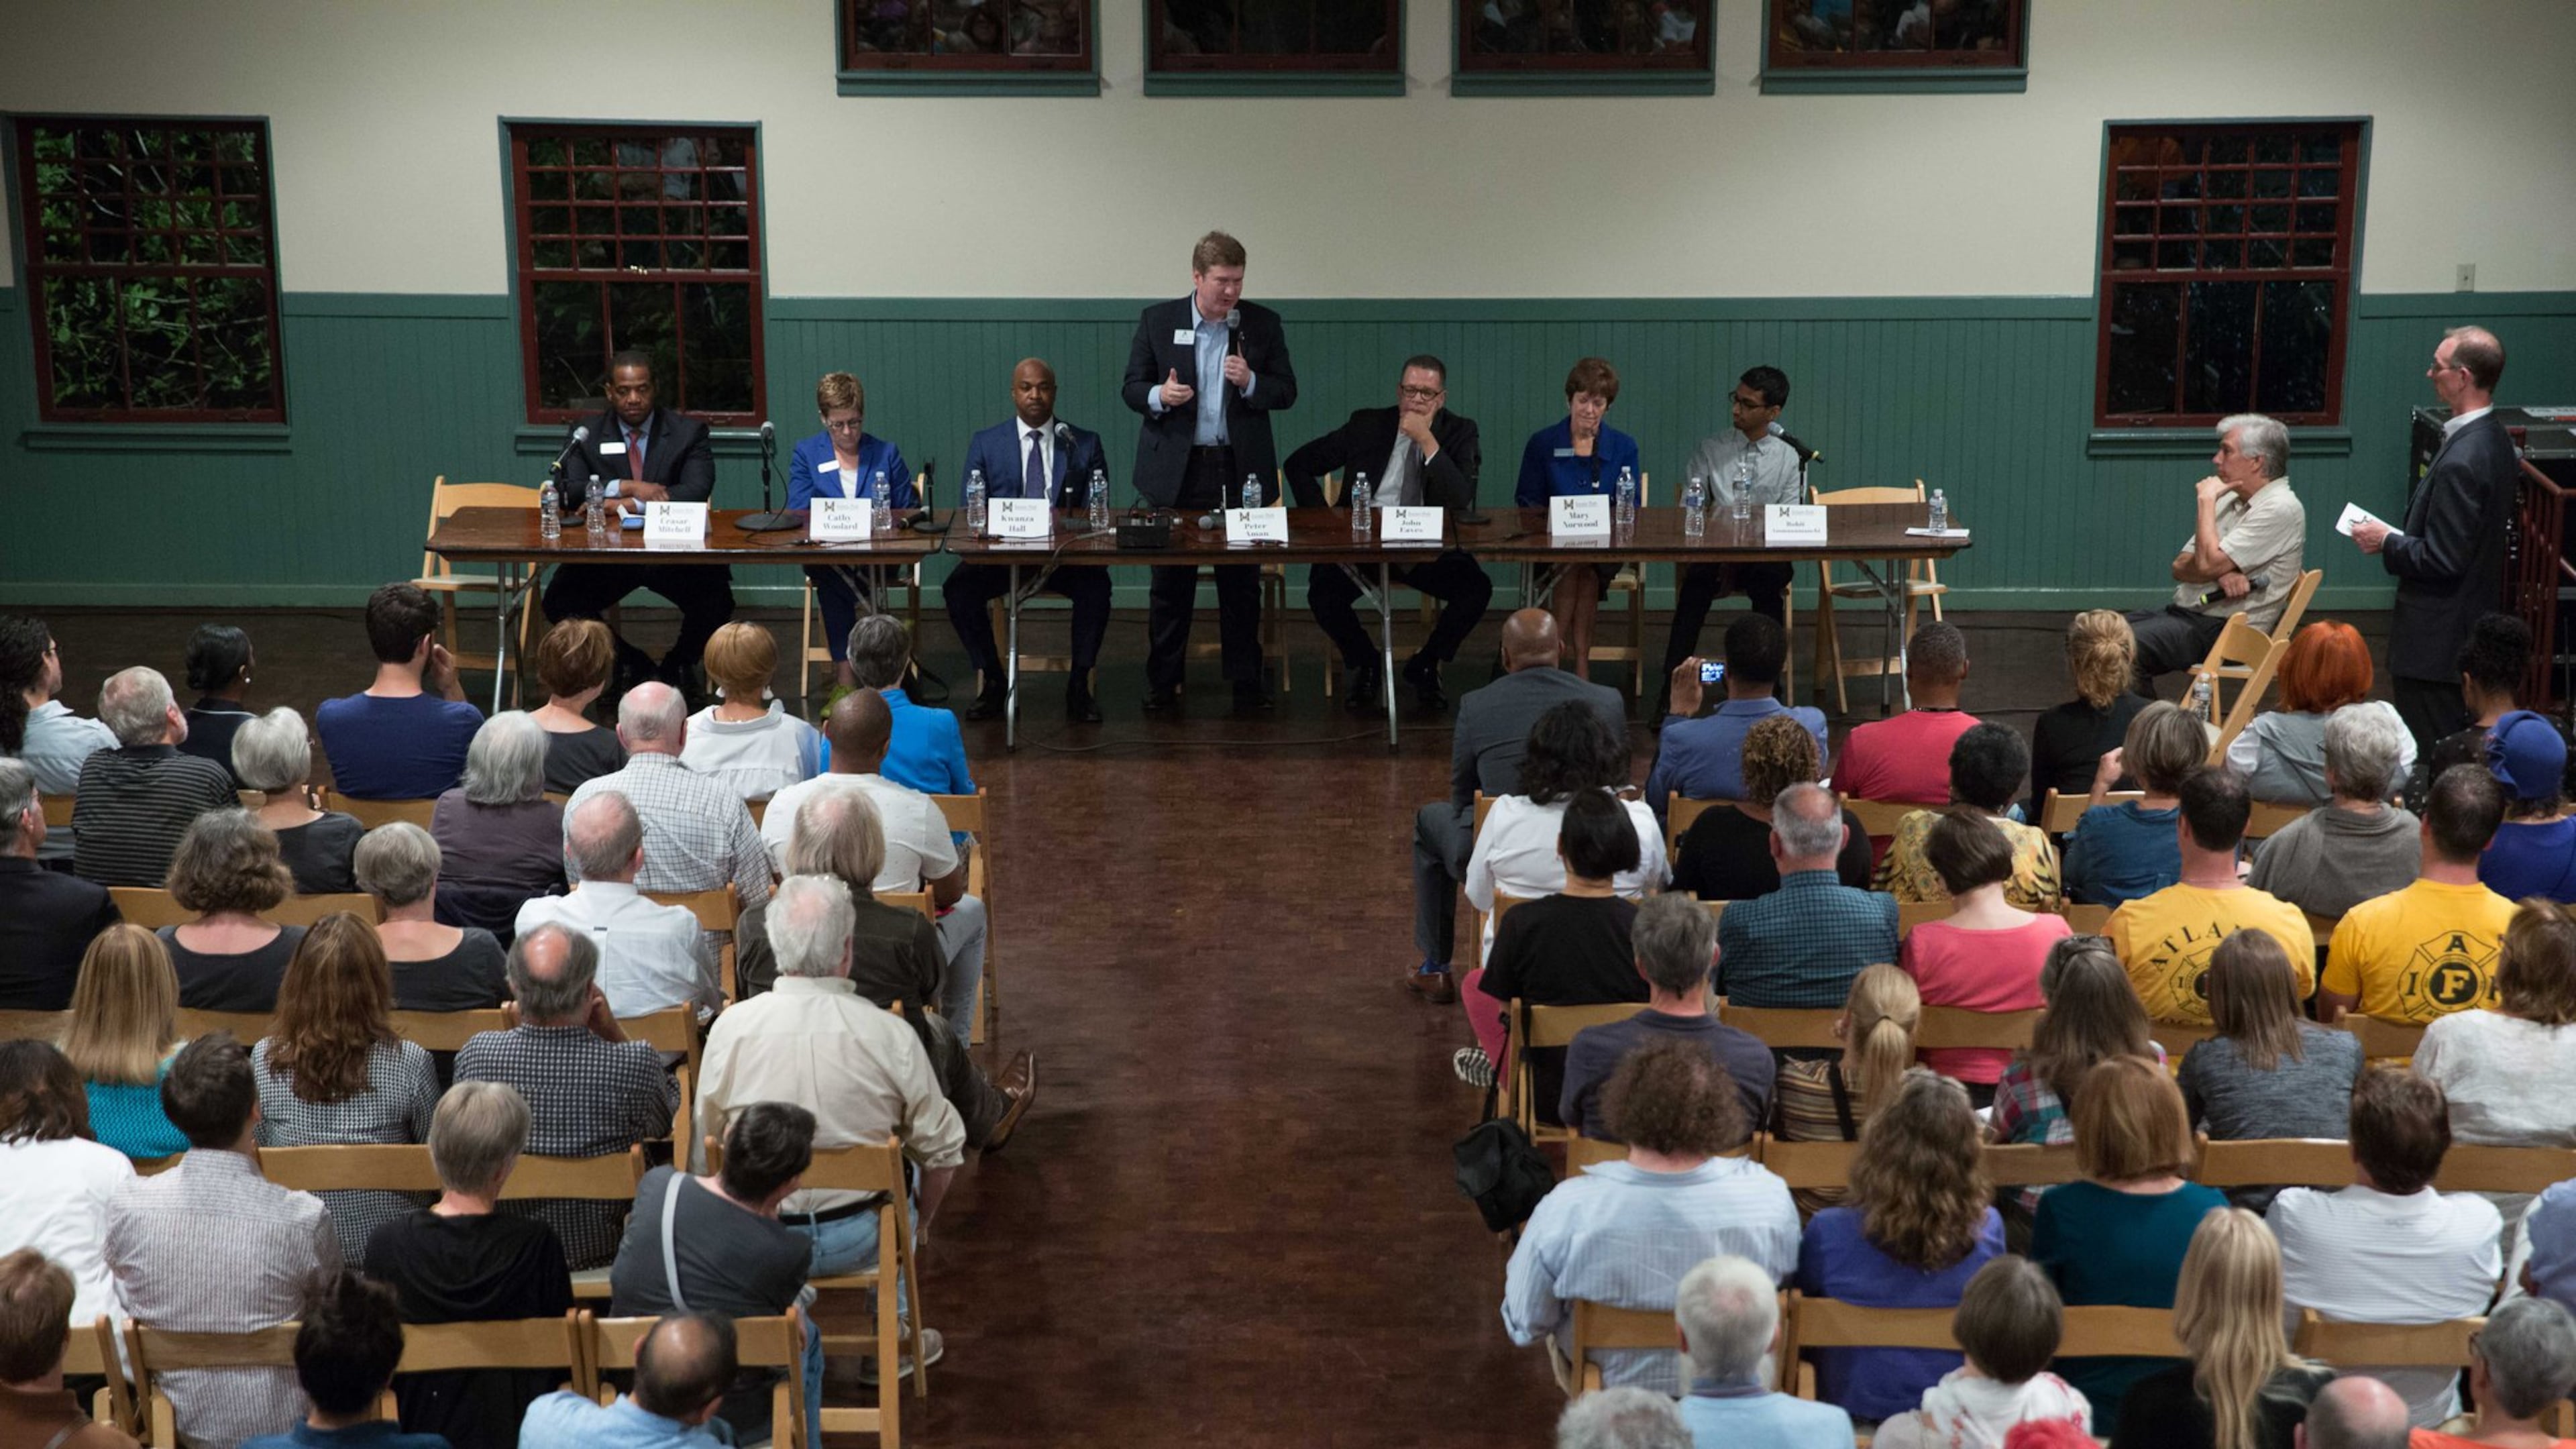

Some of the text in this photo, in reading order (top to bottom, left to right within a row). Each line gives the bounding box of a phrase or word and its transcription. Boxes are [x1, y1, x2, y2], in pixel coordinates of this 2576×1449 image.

[828, 515, 851, 523] Cathy
[1563, 520, 1598, 528] Norwood
[1570, 512, 1589, 521] Mary
[2151, 922, 2241, 973] ATLA
[2445, 935, 2469, 954] A
[2406, 972, 2418, 996] I
[2439, 969, 2470, 999] F
